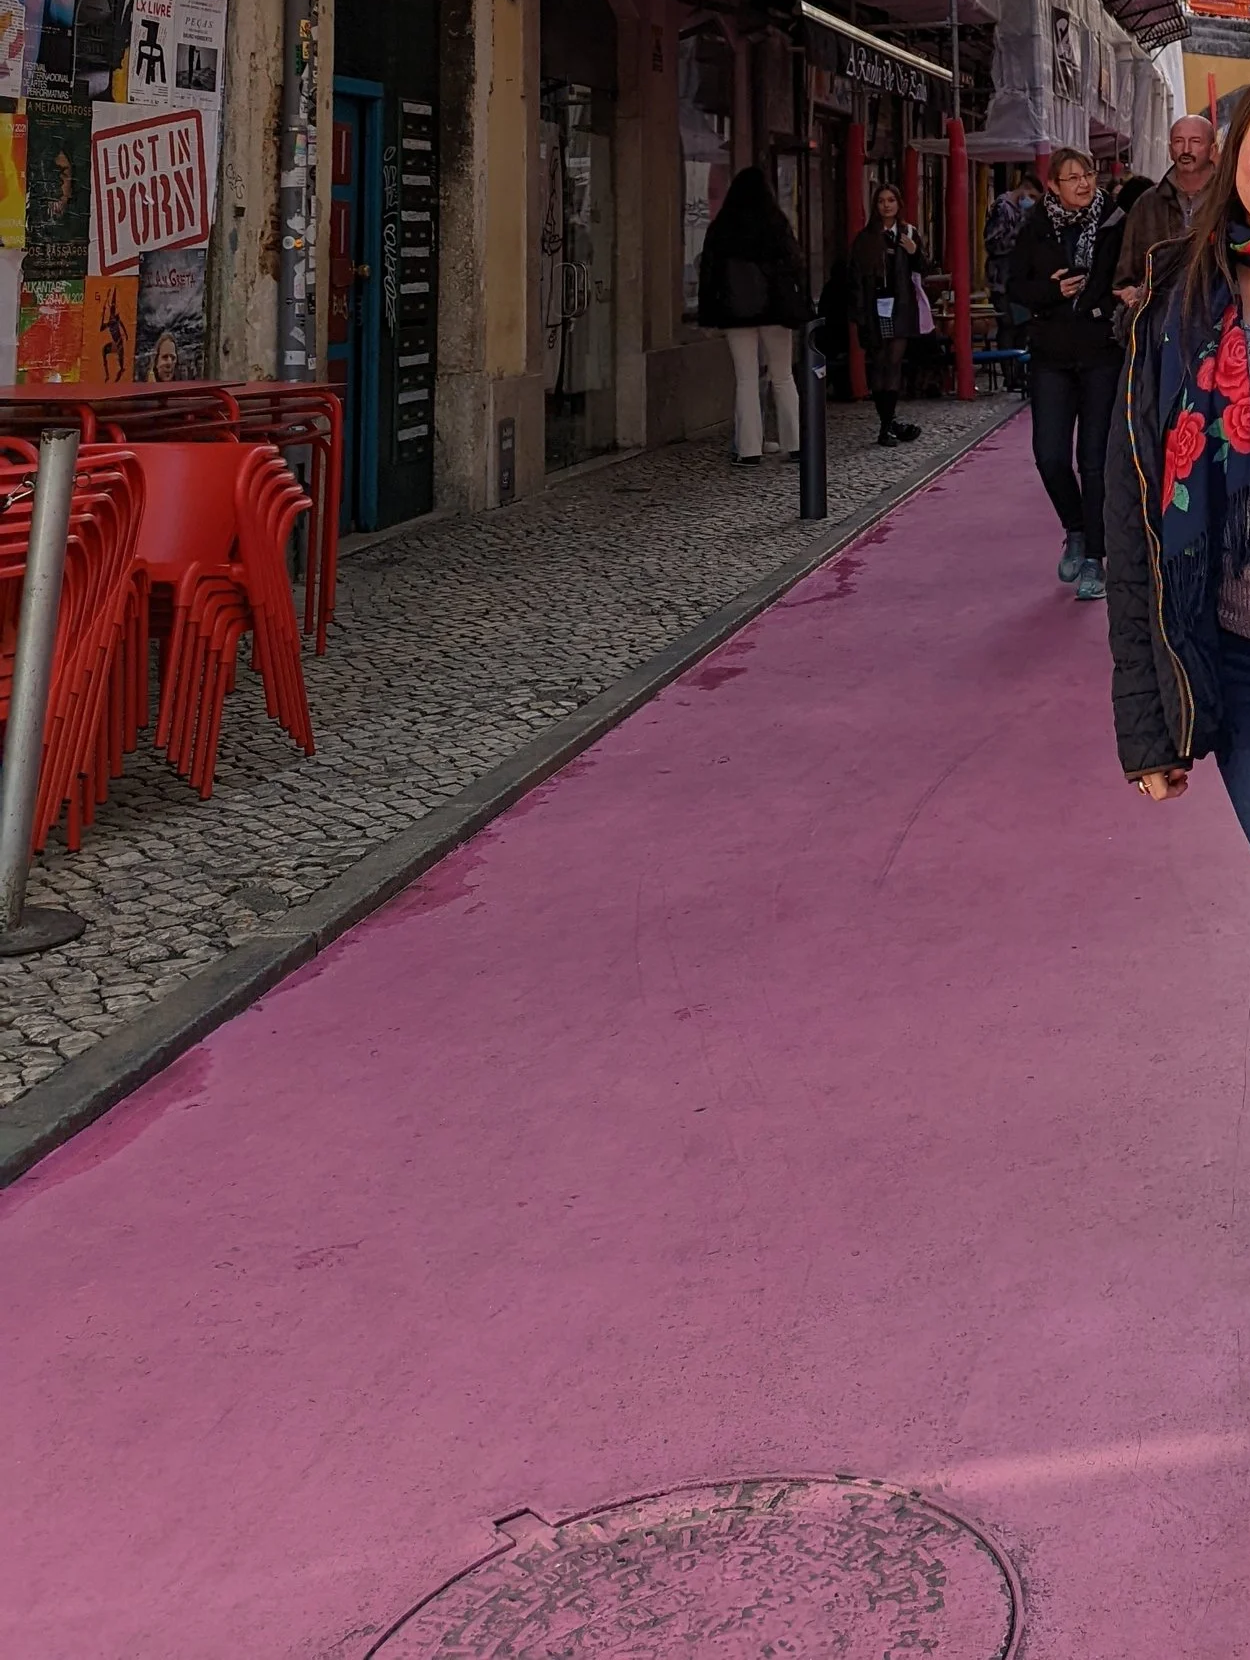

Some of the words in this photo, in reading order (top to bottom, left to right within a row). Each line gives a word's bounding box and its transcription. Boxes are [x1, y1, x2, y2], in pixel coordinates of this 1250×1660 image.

[148, 0, 172, 18] LIVRE
[28, 101, 33, 110] A
[35, 102, 92, 117] METAMORFOSE
[103, 134, 159, 186] LOST
[169, 128, 191, 168] IN
[106, 166, 195, 256] PORN
